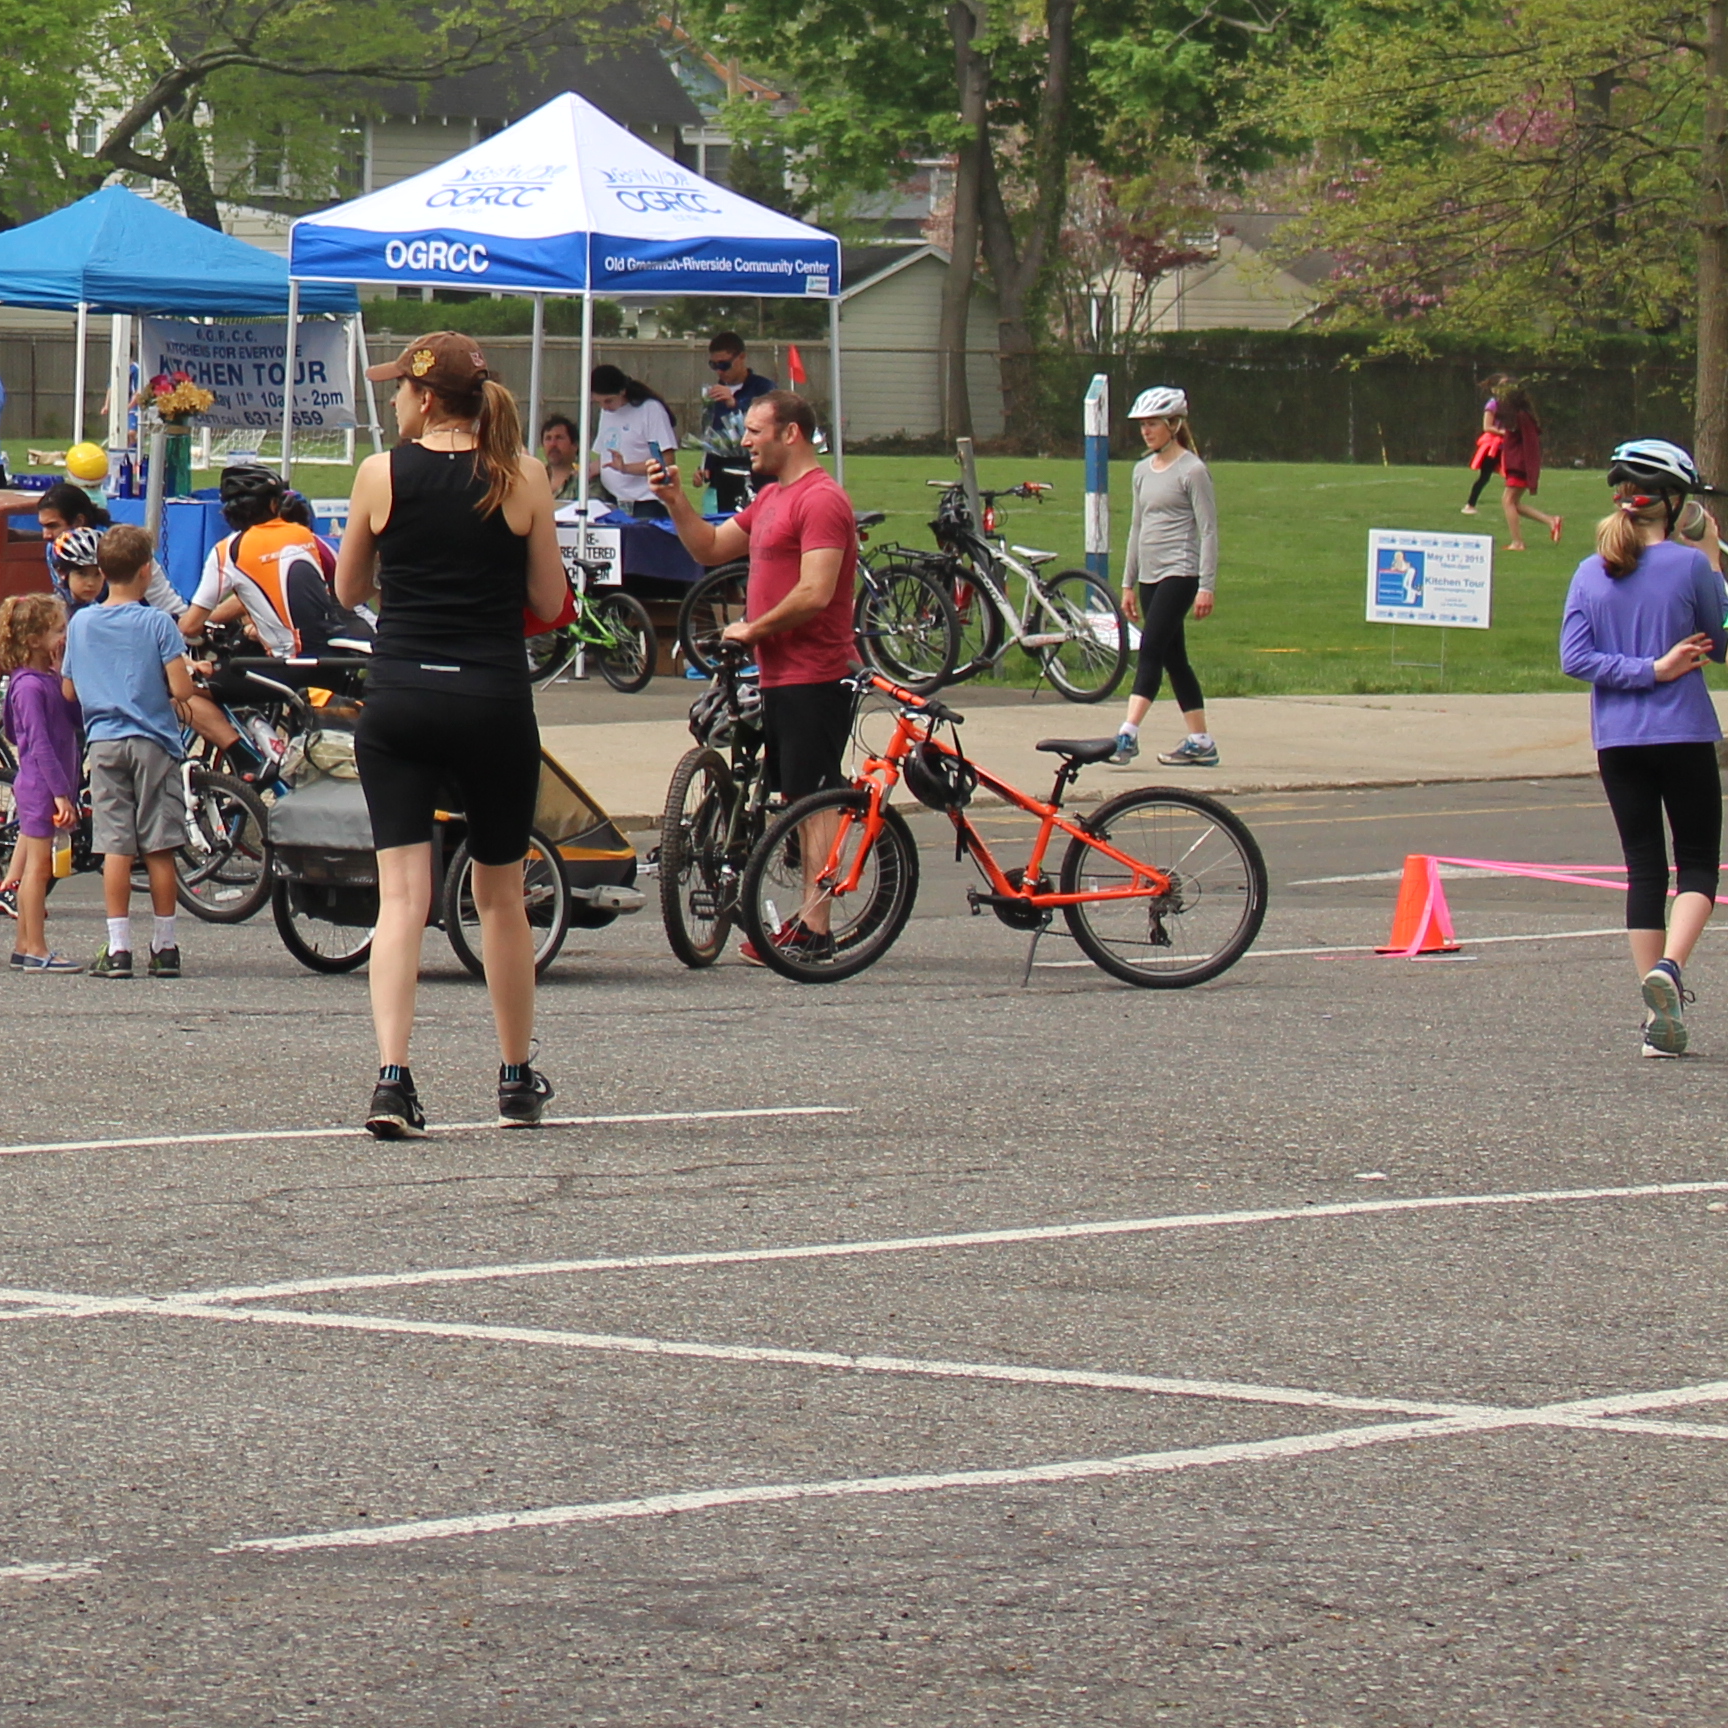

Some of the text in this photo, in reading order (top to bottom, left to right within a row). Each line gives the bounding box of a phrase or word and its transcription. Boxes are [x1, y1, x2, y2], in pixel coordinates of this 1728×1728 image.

[425, 186, 546, 208] OGRCC
[616, 190, 722, 214] OGRCC
[385, 239, 489, 273] OGRCC
[605, 256, 625, 271] Old
[734, 258, 794, 276] Community
[795, 259, 830, 273] Center
[166, 342, 302, 360] KITCHENS FOR EVERYOE
[159, 355, 243, 386] KITCHEN
[312, 390, 344, 409] 2pm
[244, 411, 324, 426] 637-659
[560, 546, 616, 559] REGTERED
[1427, 553, 1444, 562] May
[1465, 555, 1485, 564] 2015
[1425, 576, 1485, 588] Kitchen Tour
